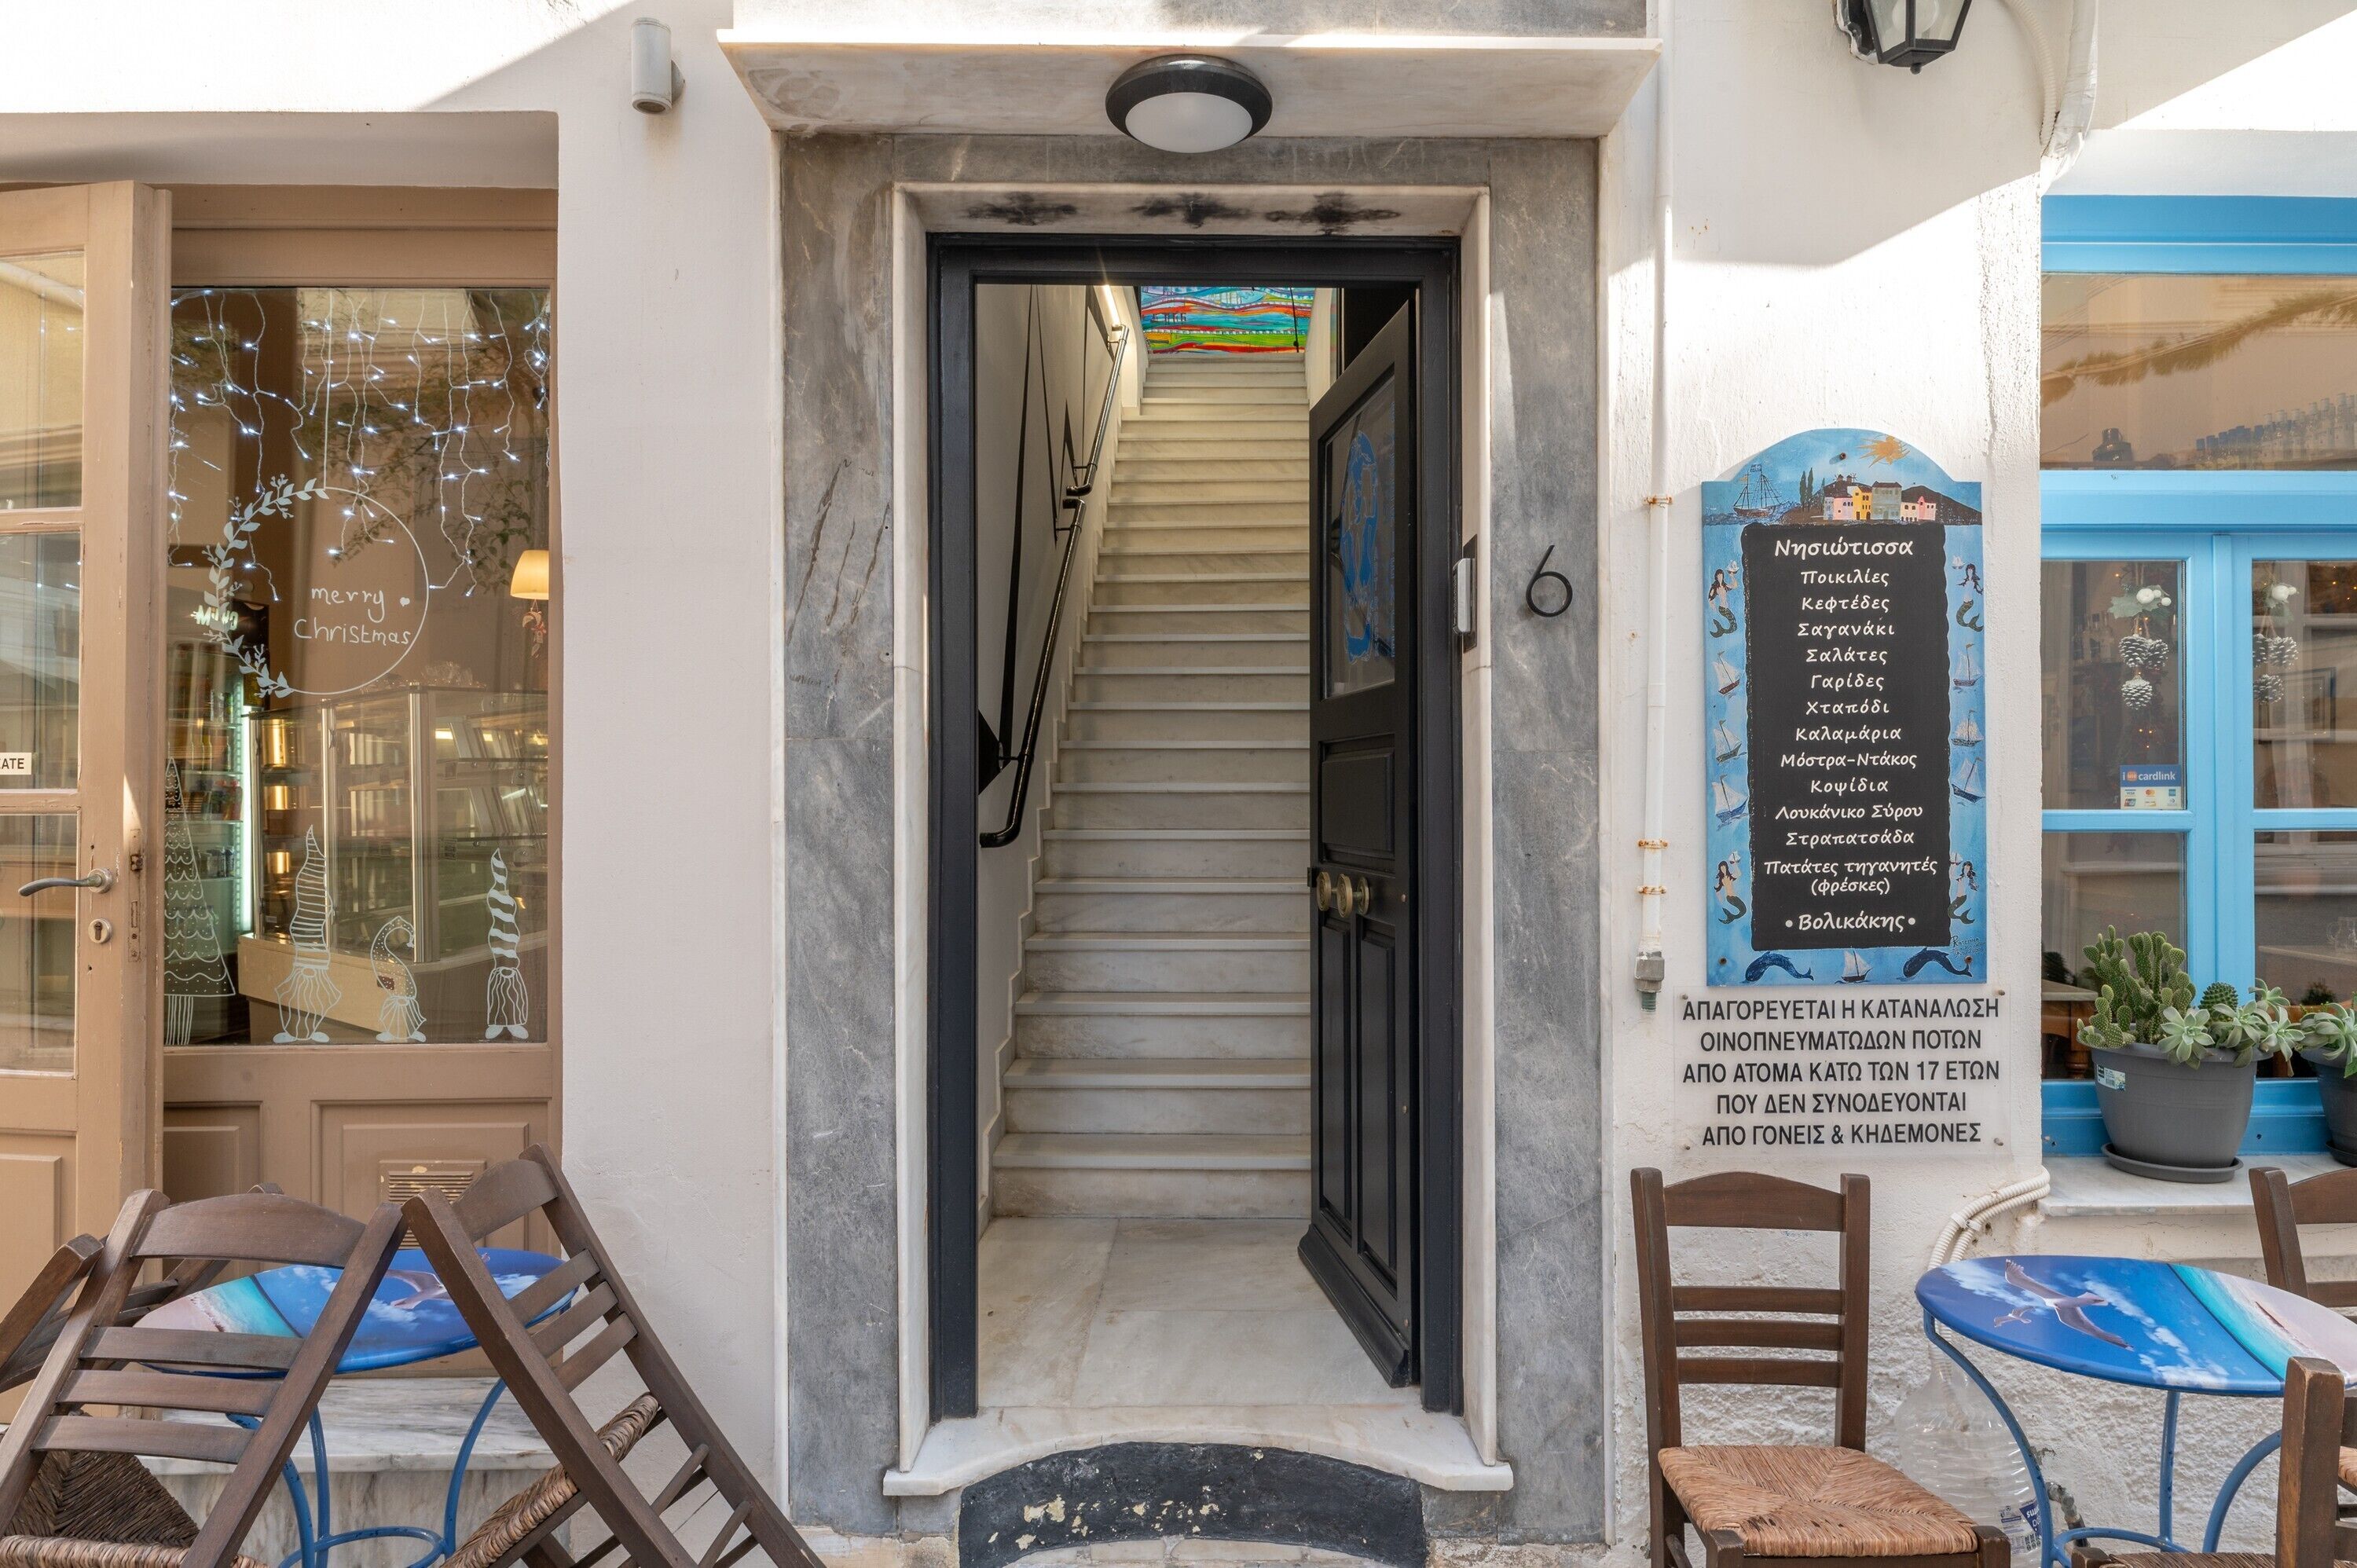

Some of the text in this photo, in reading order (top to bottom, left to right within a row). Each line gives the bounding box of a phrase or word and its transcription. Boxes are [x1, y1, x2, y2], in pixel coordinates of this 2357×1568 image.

[1775, 537, 1913, 560] Νησιώτισσα
[1526, 544, 1573, 617] 6
[1801, 568, 1889, 587] Ποικιλίες
[311, 588, 385, 624] merry
[1802, 595, 1890, 613] Κεφτέδες
[294, 617, 411, 646] Christmas
[1798, 621, 1894, 639] Σαγανάκι
[1806, 647, 1887, 665] Σαλάτες
[1811, 672, 1884, 691] Γαρίδες
[1806, 699, 1889, 715] Χταπόδι
[1796, 725, 1901, 743] Καλαμάρια
[0, 757, 25, 770] ATE
[1781, 750, 1917, 770] Μόστρα-Ντάκος
[2139, 771, 2176, 780] cardlink
[1811, 777, 1888, 796] Κοψίδια
[1776, 803, 1923, 821] Λουκάνικο Σύρου
[1786, 829, 1914, 848] Στραπατσάδα
[1764, 856, 1937, 877] Πατάτες τηγανητές
[1812, 877, 1890, 896] (φρέσκες)
[1799, 910, 1905, 932] Βολικάκης
[1682, 998, 1998, 1020] ΑΠΑΓΟΡΕΥΕΤΑΙ Η ΚΑΤΑΝΑΛΩΣΗ
[1701, 1030, 1981, 1051] ΟΙΝΟΠΝΕΥΜΑΤΩΔΩΝ ΠΟΤΩΝ
[1683, 1061, 1999, 1083] ΑΠΟ ΑΤΟΜΑ ΚΑΤΩ ΤΩΝ 17 ΕΤΩΝ
[1717, 1092, 1965, 1114] ΠΟΥ ΔΕΝ ΣΥΝΟΔΕΥΟΝΤΑΙ
[1703, 1123, 1981, 1145] ΑΠΟ ΓΟΝΕΙΣ & ΚΗΔΕΜΟΝΕΣ
